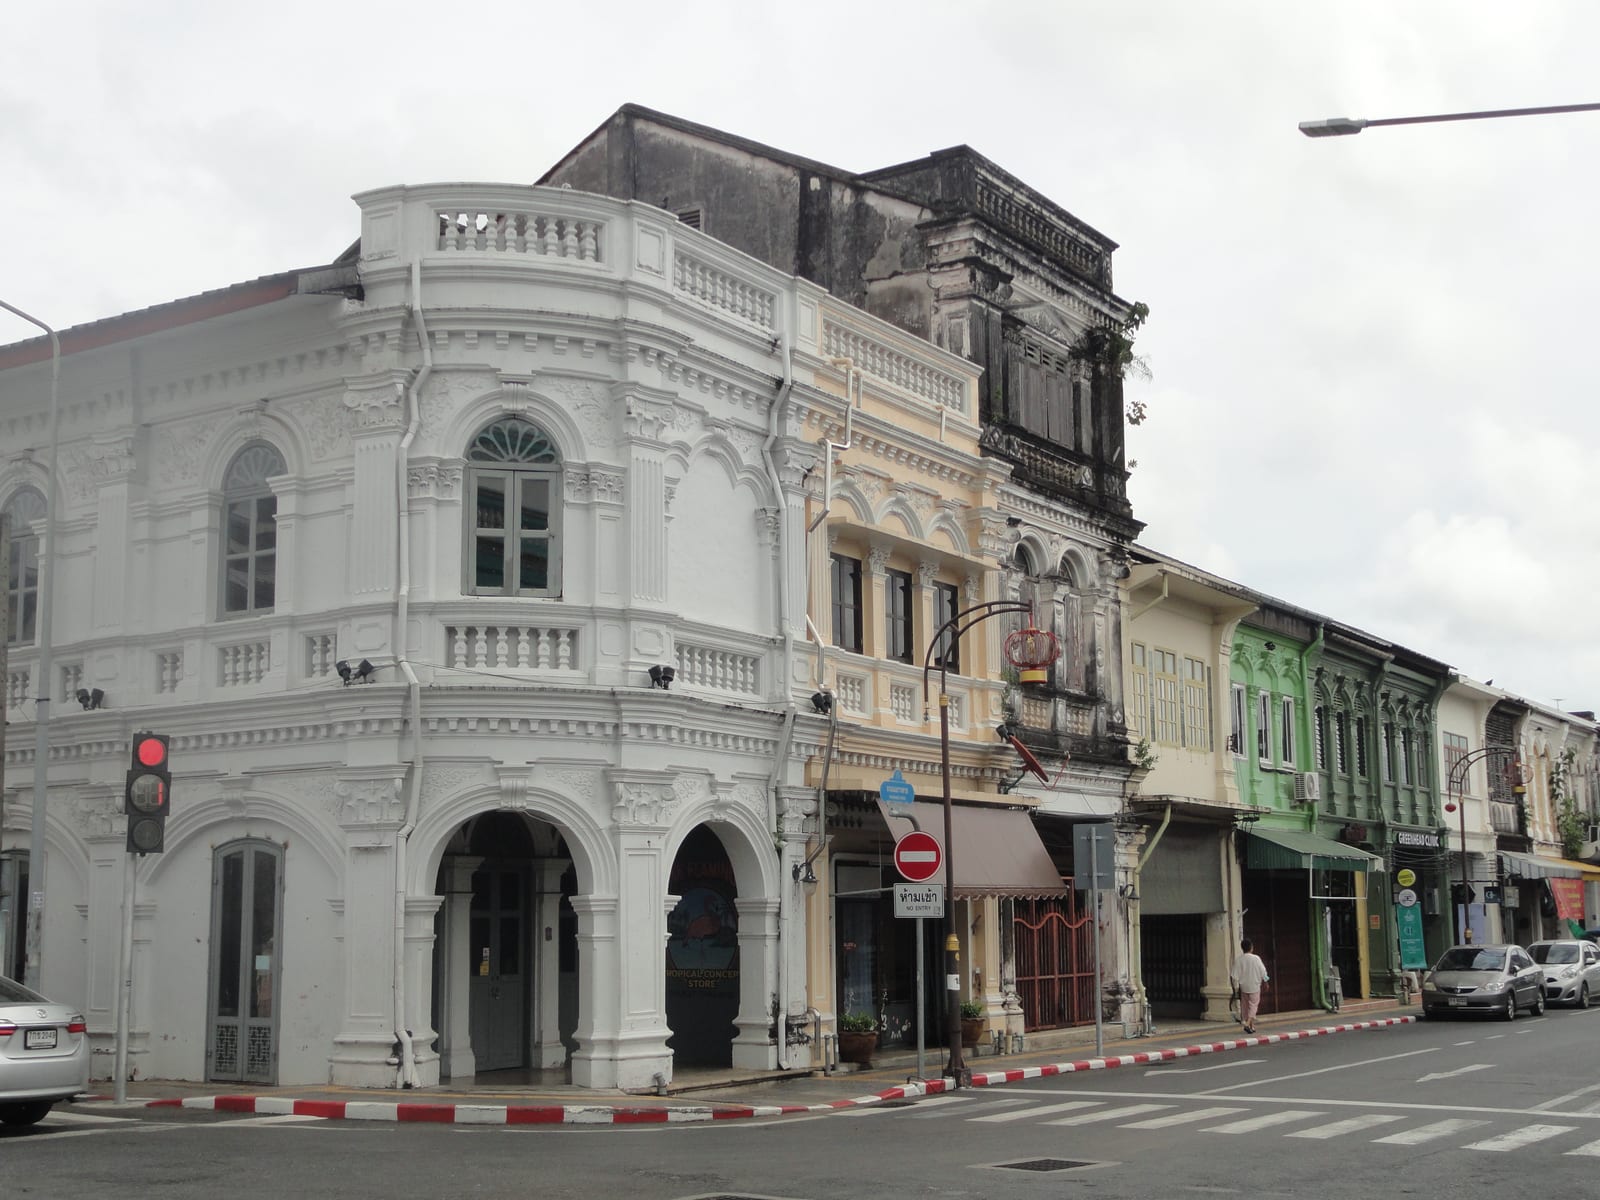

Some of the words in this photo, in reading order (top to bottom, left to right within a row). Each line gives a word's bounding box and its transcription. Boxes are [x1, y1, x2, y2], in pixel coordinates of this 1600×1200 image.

[1398, 831, 1425, 846] GREENHEAD
[1425, 834, 1439, 847] CLINIC
[899, 887, 937, 903] ห้ามเข้า
[666, 968, 703, 978] ROPICAL
[703, 969, 738, 979] CONCEP
[688, 979, 715, 988] STORE
